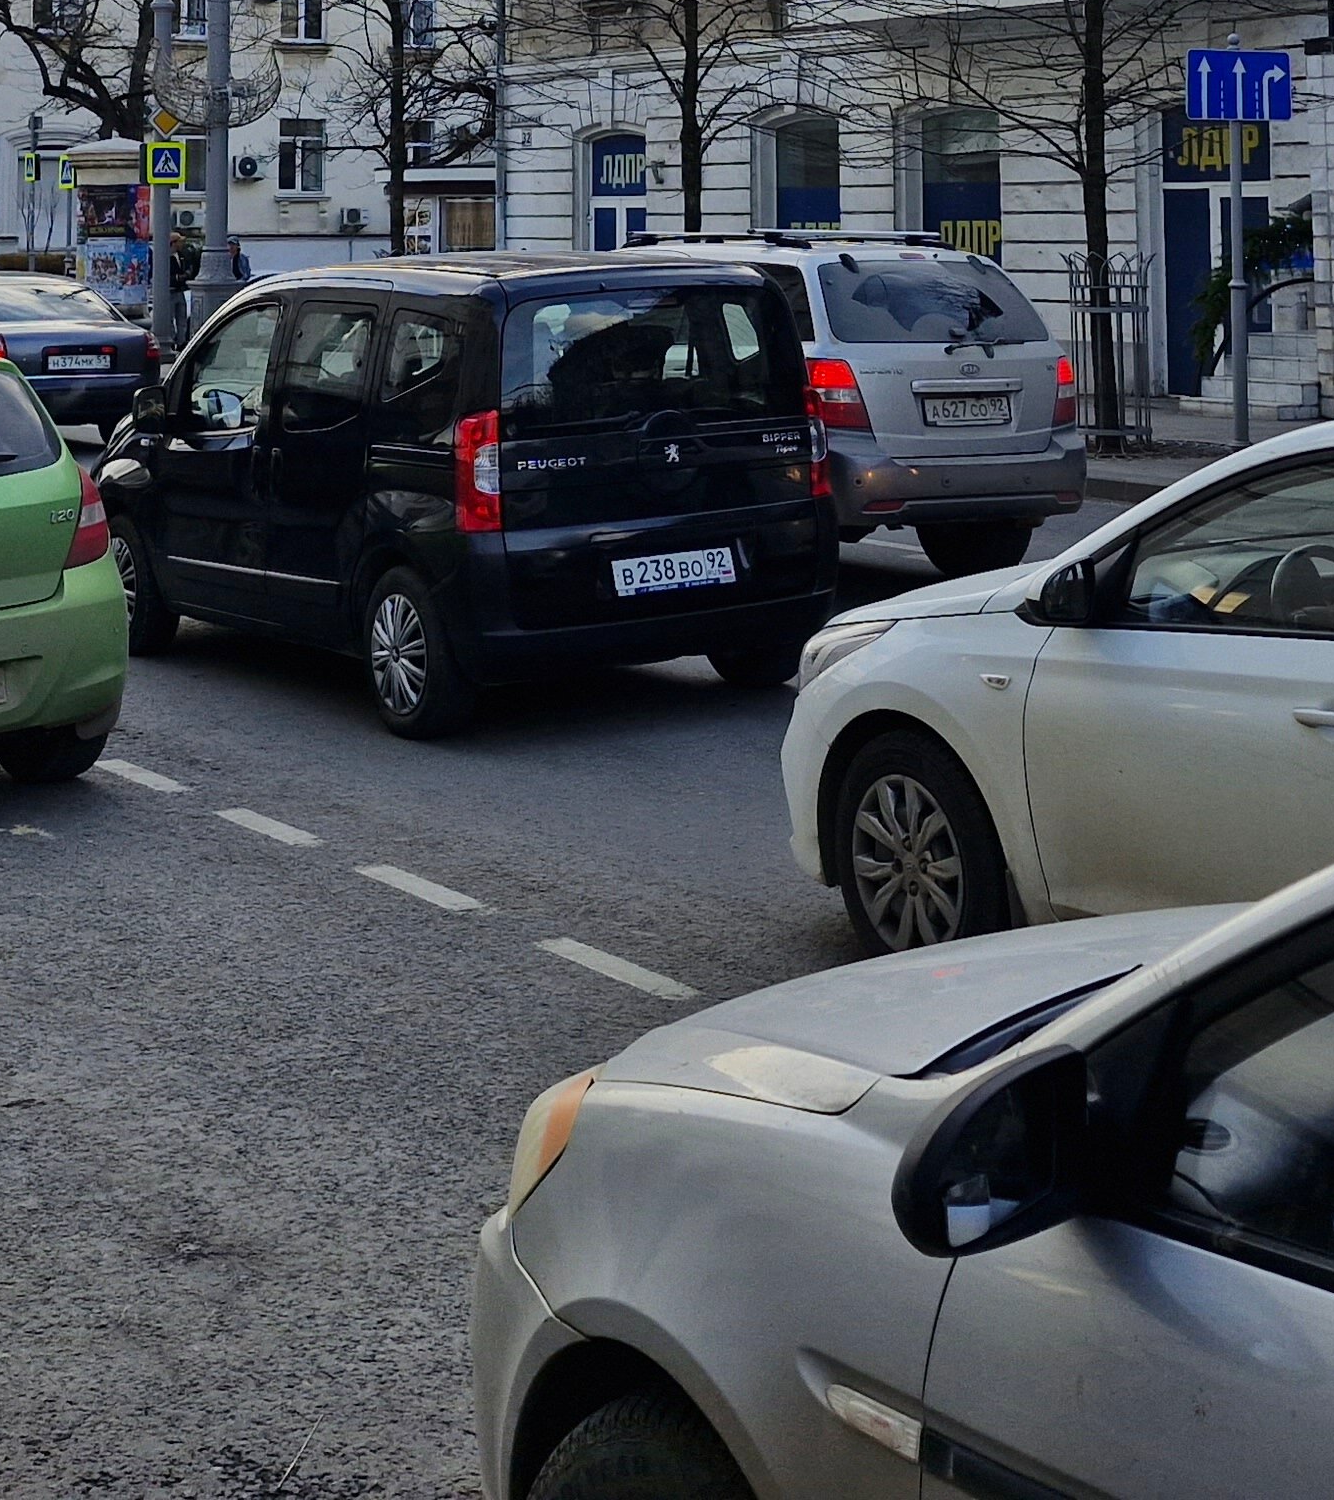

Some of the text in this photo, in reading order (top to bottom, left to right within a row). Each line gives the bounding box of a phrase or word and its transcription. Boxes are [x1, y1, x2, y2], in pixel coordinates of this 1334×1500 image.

[600, 153, 646, 189] ЛДПР
[96, 355, 108, 364] 51
[990, 398, 1005, 412] 92
[762, 431, 801, 443] BIPPER
[517, 456, 587, 471] PEUGEOT
[706, 550, 726, 569] 92
